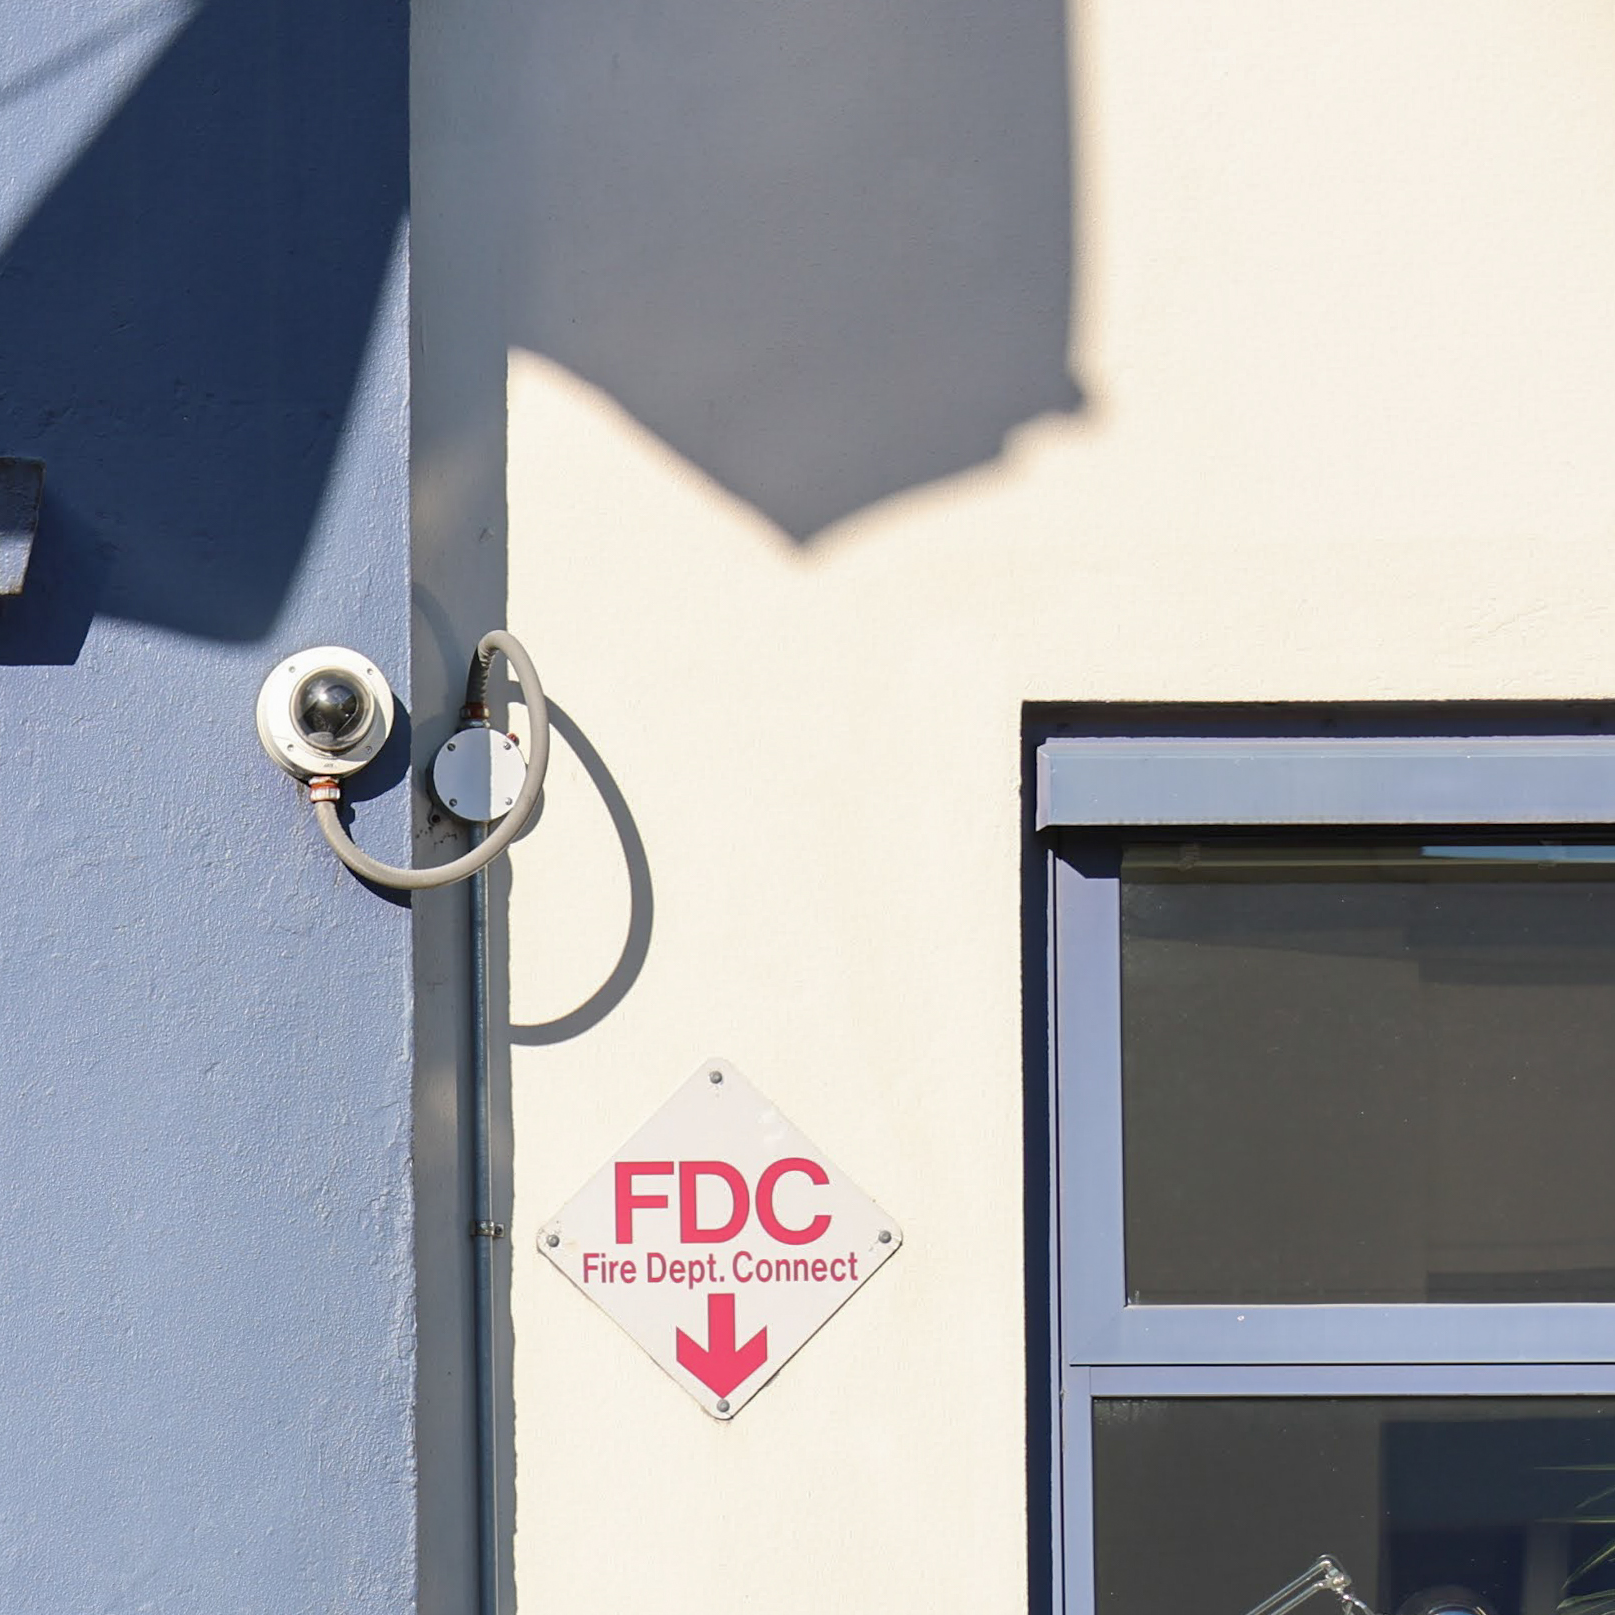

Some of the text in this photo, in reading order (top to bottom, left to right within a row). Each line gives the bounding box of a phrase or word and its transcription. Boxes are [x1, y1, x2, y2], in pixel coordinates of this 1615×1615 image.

[614, 1156, 832, 1245] FDC
[583, 1250, 858, 1290] Fire Dept. Connect
